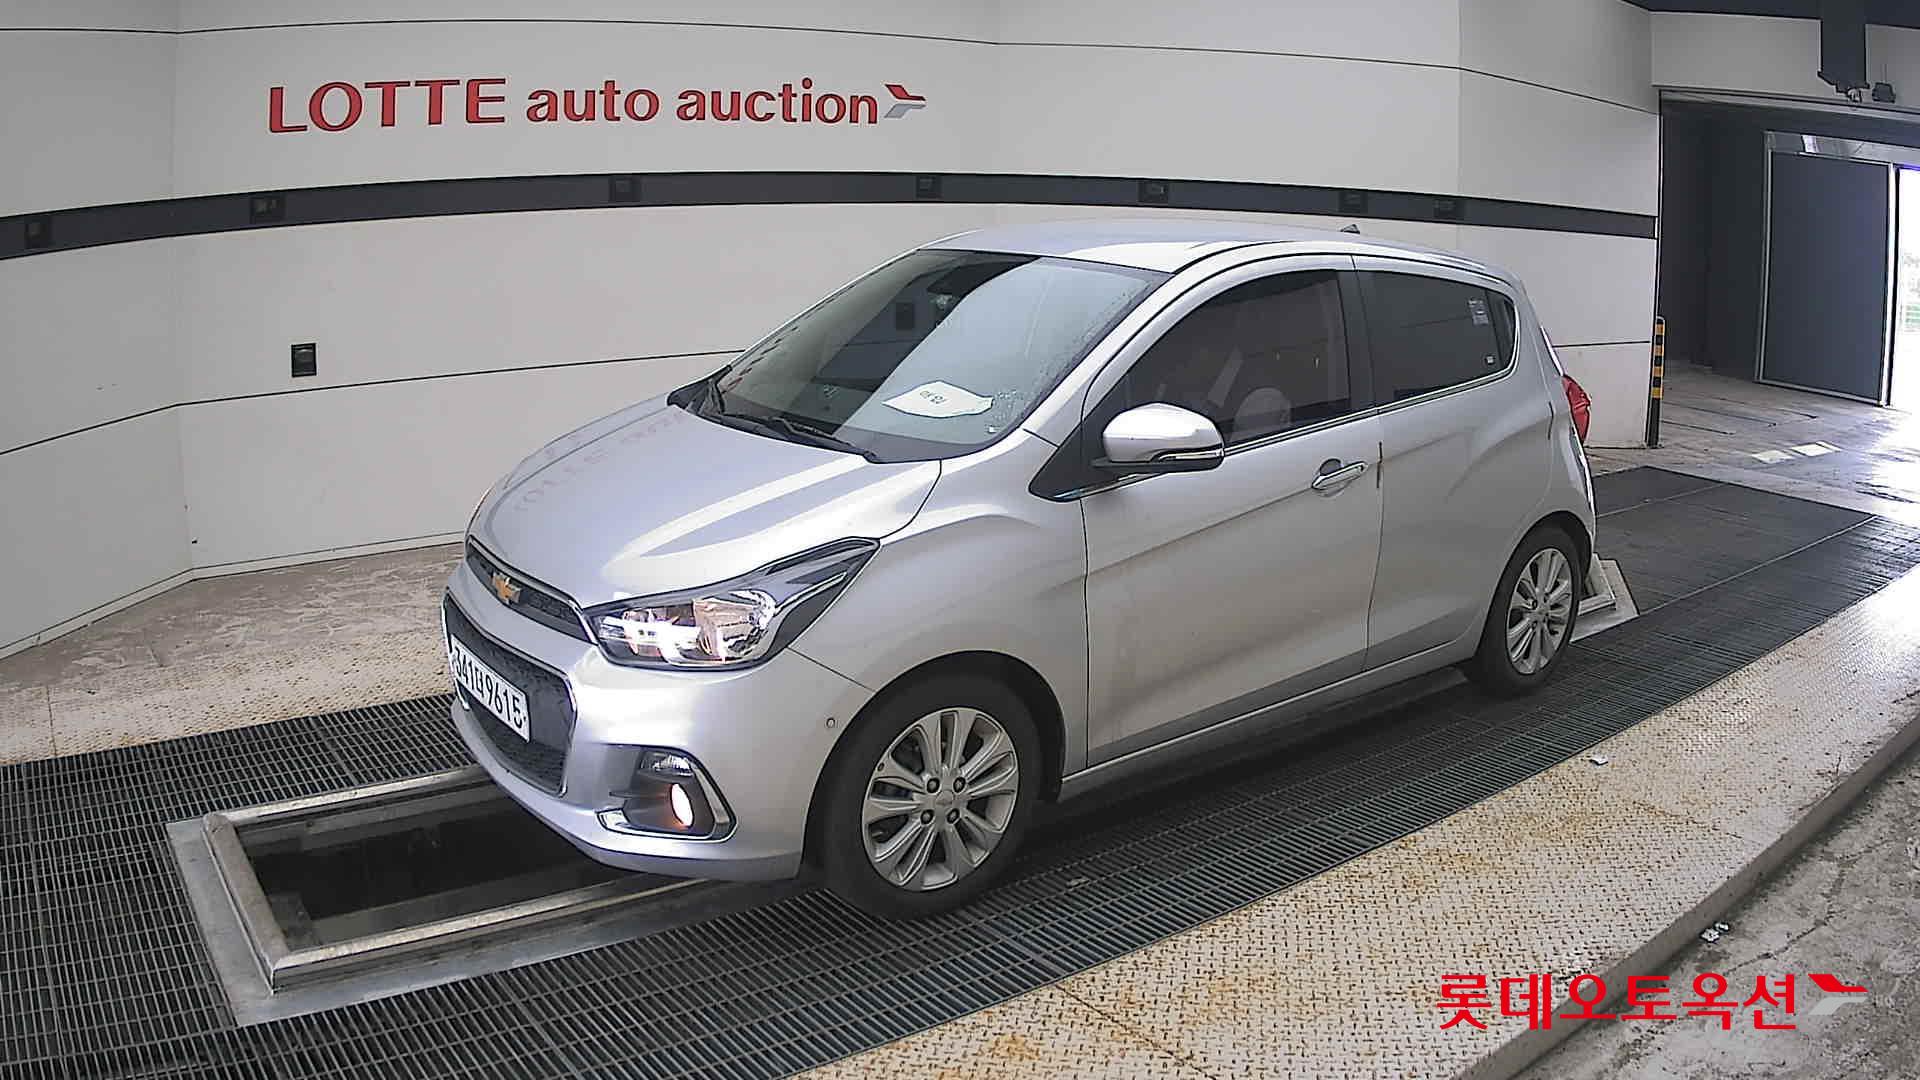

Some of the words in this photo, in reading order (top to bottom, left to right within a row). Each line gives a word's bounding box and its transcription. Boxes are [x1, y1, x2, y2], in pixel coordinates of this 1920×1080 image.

[268, 77, 506, 134] LOTTE
[525, 79, 661, 124] auto
[675, 77, 880, 126] auction
